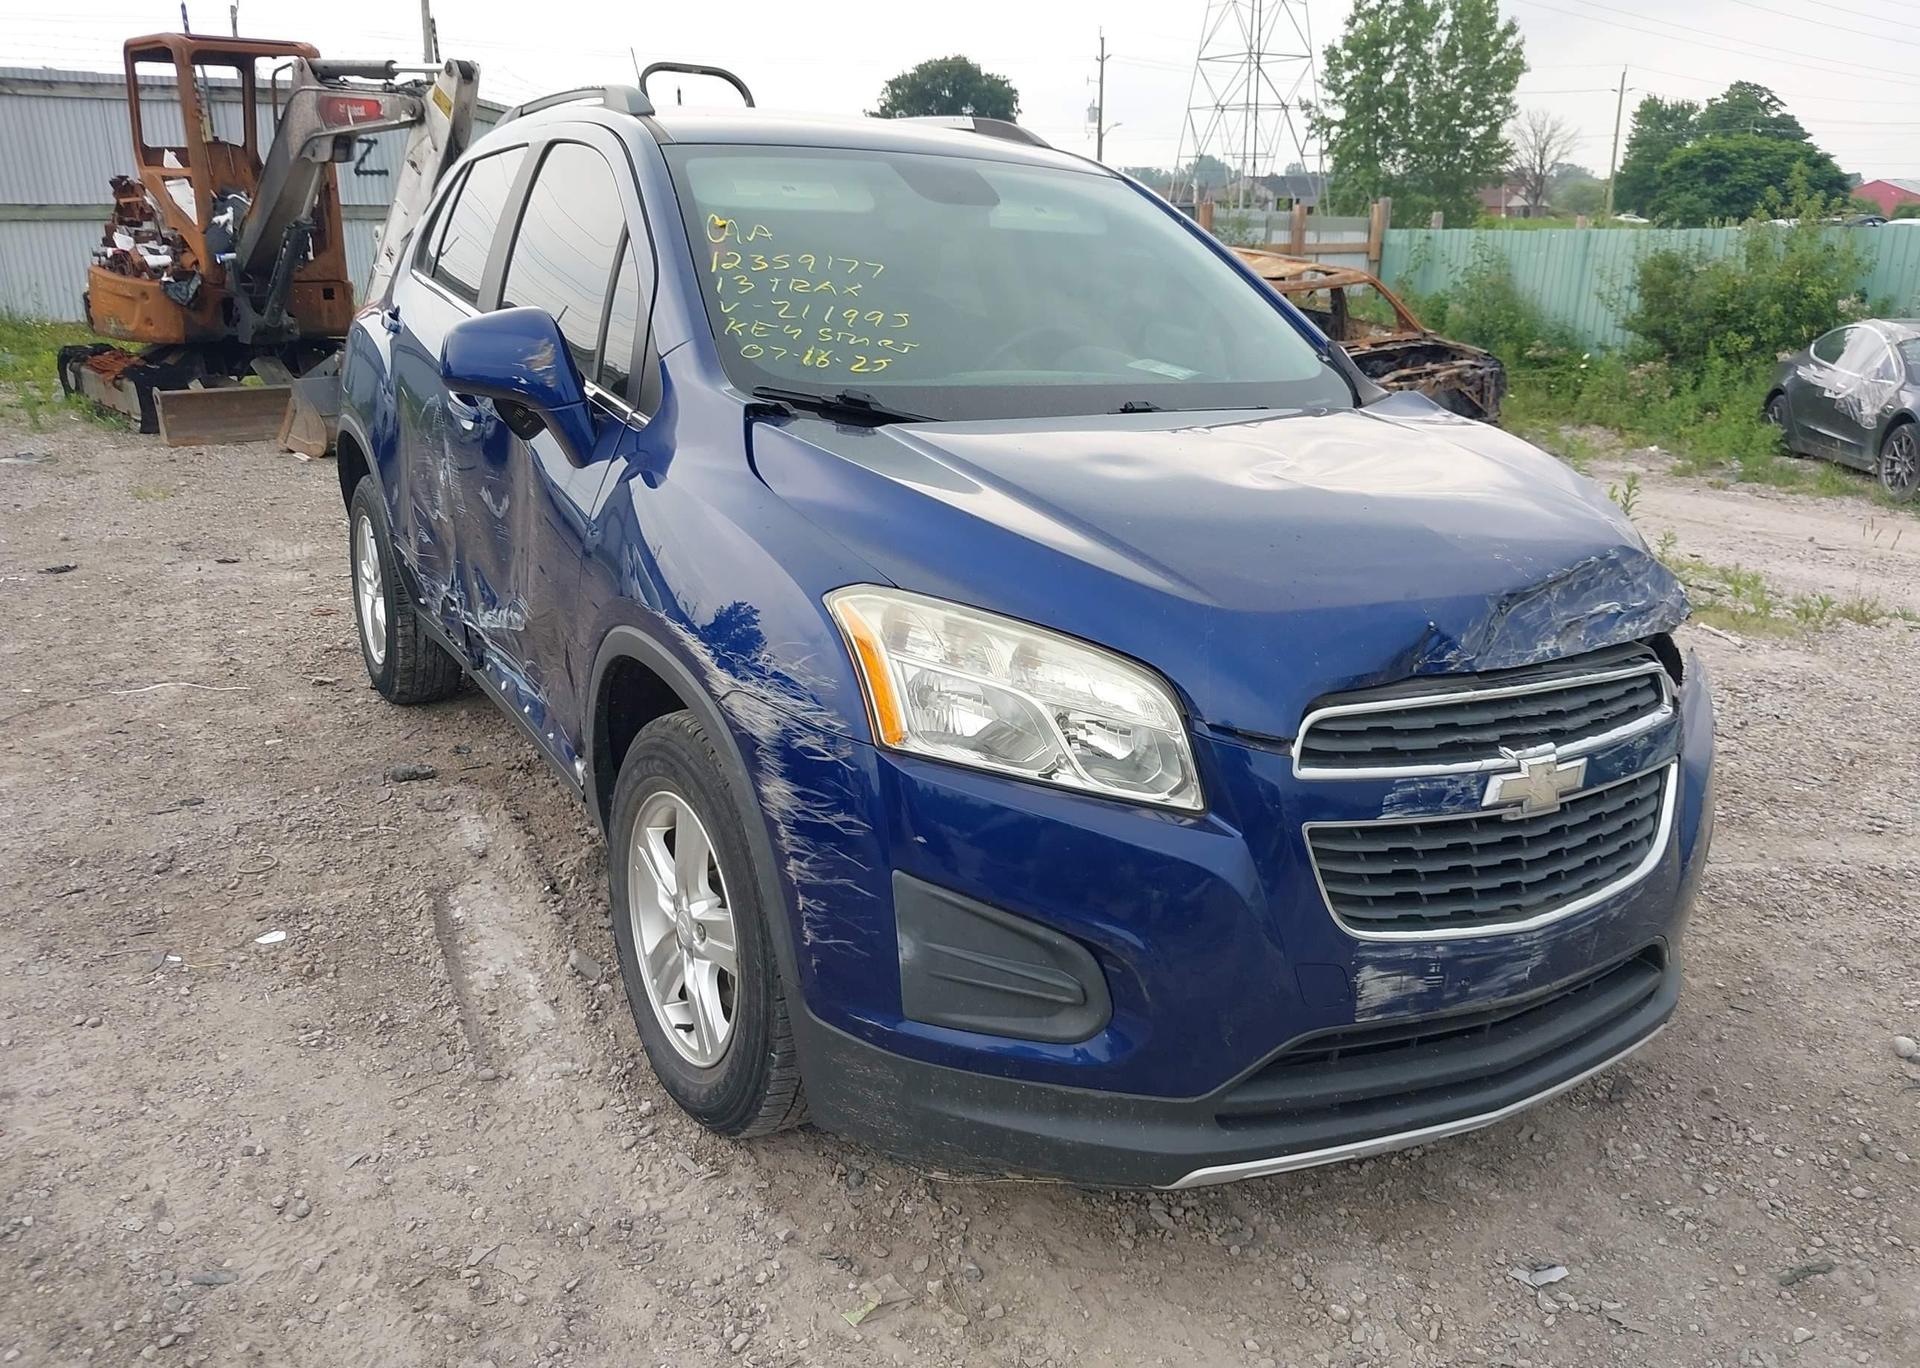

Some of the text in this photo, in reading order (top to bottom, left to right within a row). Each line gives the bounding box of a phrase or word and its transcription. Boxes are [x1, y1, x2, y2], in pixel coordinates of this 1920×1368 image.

[711, 251, 885, 279] 12359177
[716, 275, 864, 297] 13 TRAX
